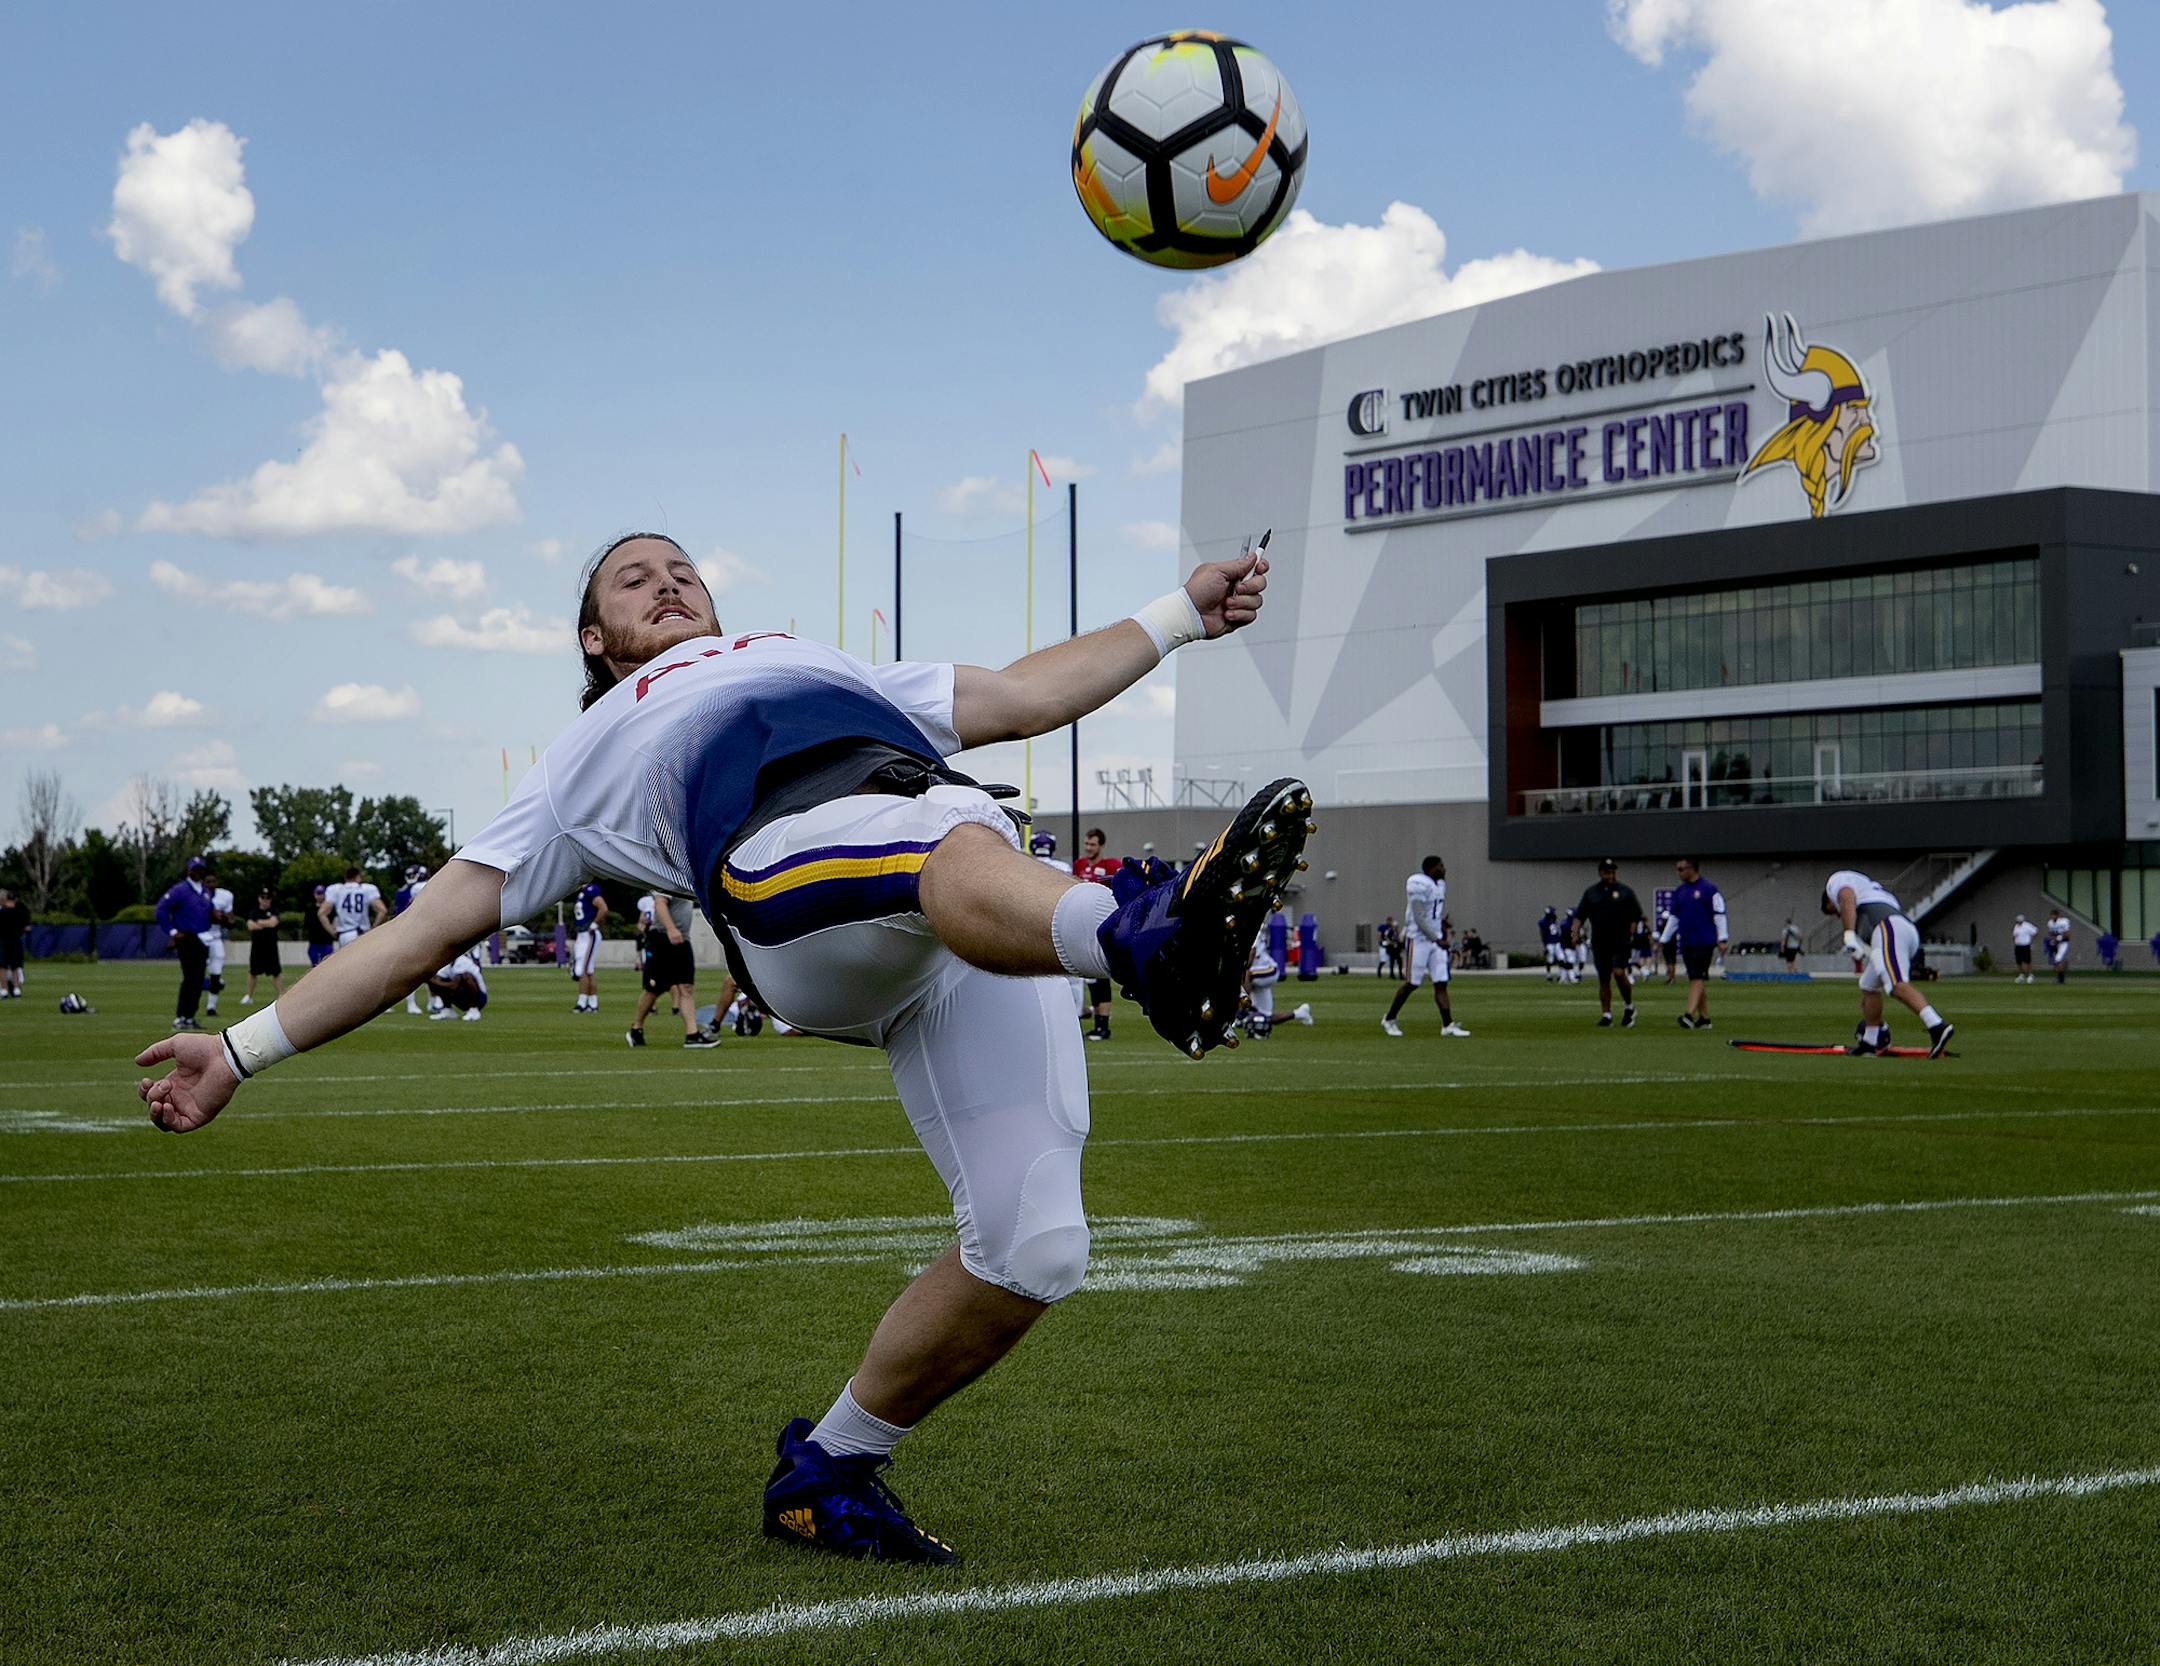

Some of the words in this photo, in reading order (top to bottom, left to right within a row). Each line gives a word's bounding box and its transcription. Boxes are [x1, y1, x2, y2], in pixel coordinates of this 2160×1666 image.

[1400, 384, 1462, 421] TWIN
[1470, 368, 1547, 410] CITIES
[1555, 331, 1745, 396] ORTHOPEDICS
[1344, 426, 1589, 521] PERFORMANCE
[1602, 401, 1750, 483] CENTER
[341, 893, 364, 913] 48
